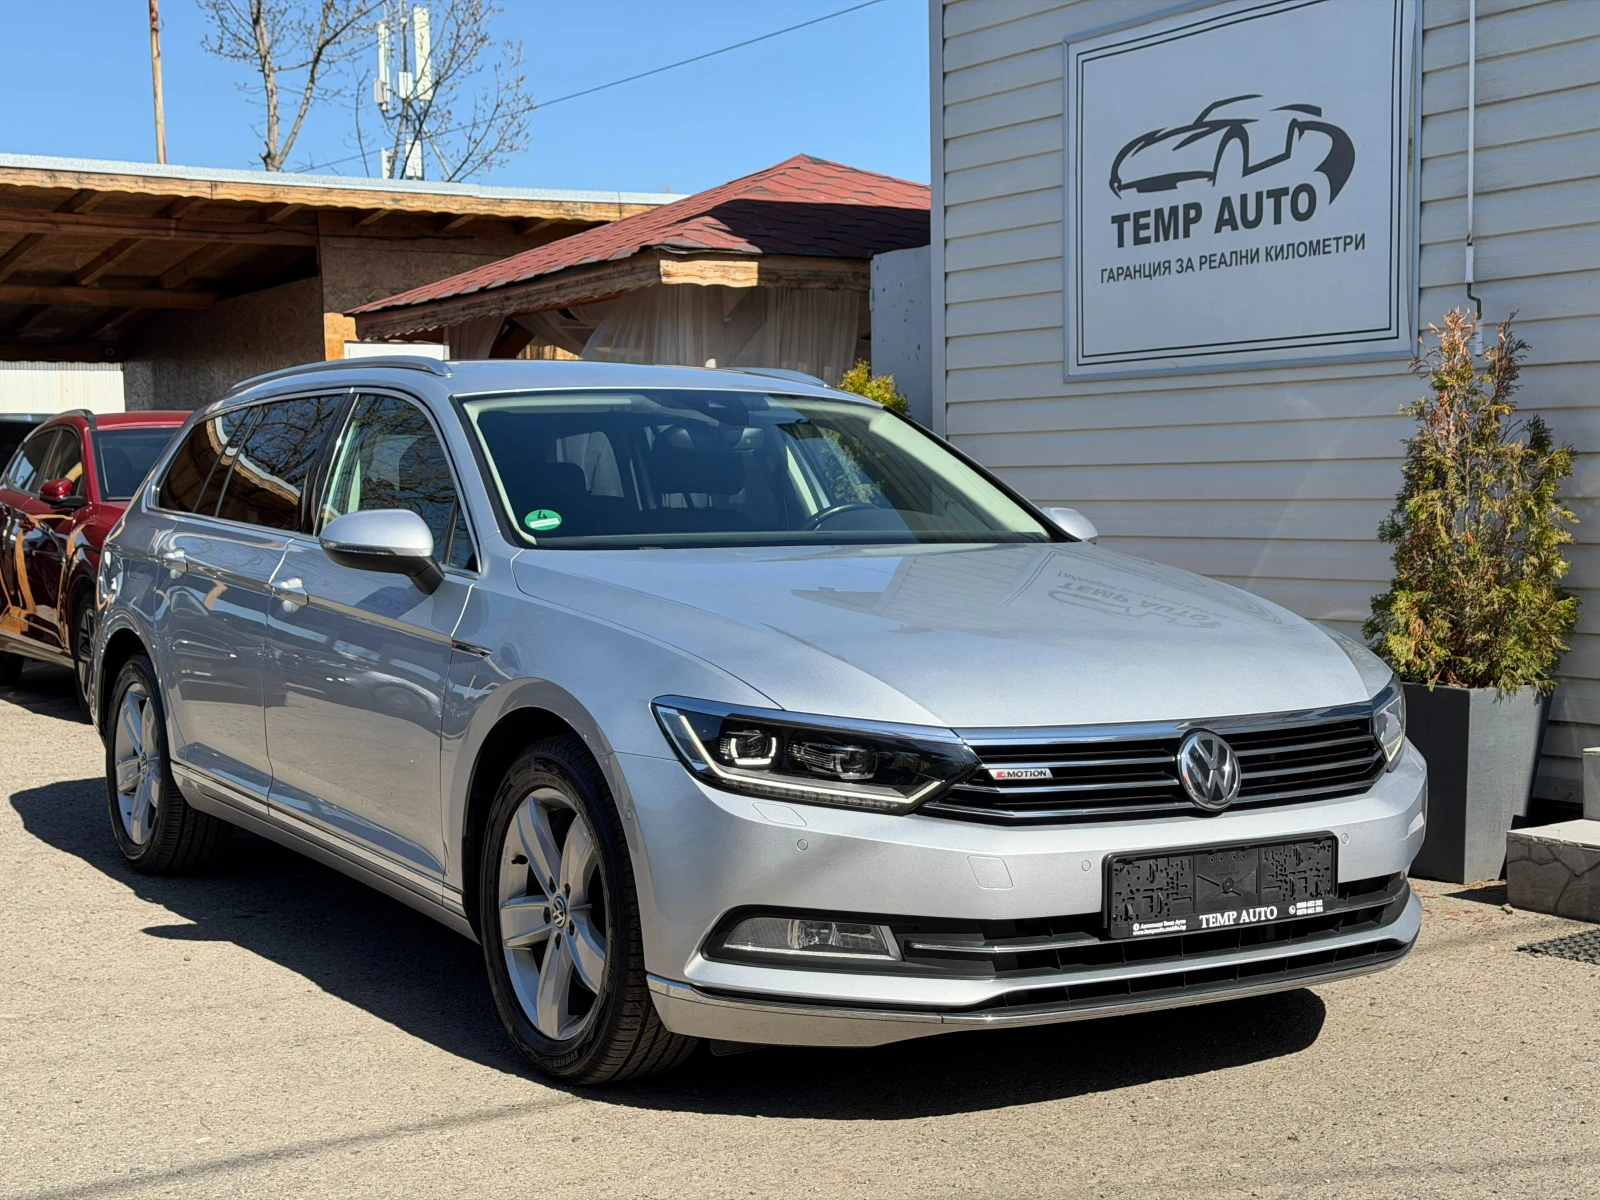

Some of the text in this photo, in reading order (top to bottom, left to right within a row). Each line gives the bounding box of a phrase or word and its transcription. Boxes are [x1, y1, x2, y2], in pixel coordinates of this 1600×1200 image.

[1111, 183, 1317, 248] TEMP AUTO
[1100, 233, 1366, 284] ГАРАНЦИЯ ЗА РЕАЛНИ КИЛОМЕТРИ
[537, 510, 548, 520] 4
[1199, 911, 1237, 929] TEMP
[1239, 905, 1278, 924] AUTO
